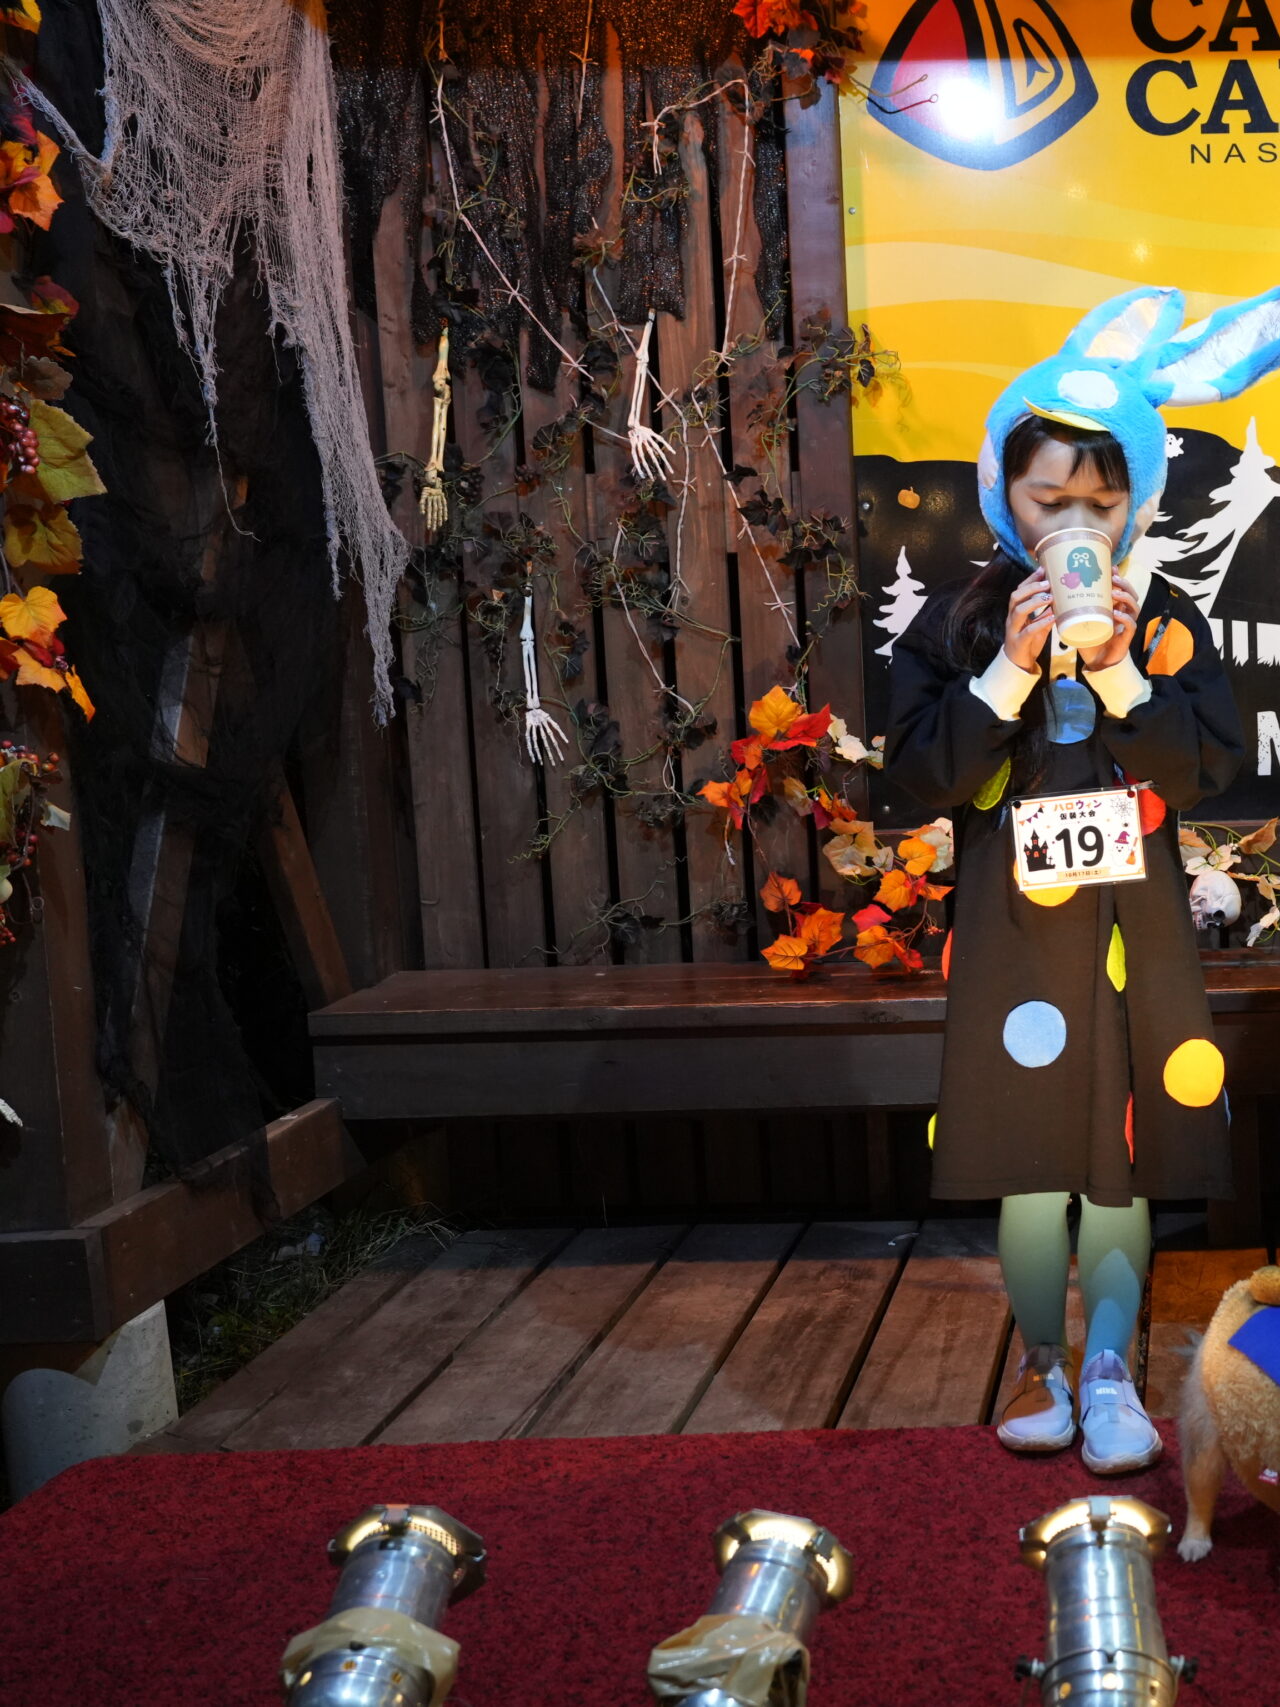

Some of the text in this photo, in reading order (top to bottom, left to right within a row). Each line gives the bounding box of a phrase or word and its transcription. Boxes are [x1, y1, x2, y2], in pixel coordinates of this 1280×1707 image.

[1054, 800, 1102, 811] ハロウィン
[1060, 809, 1096, 820] 仮装大会
[1055, 825, 1104, 869] 19
